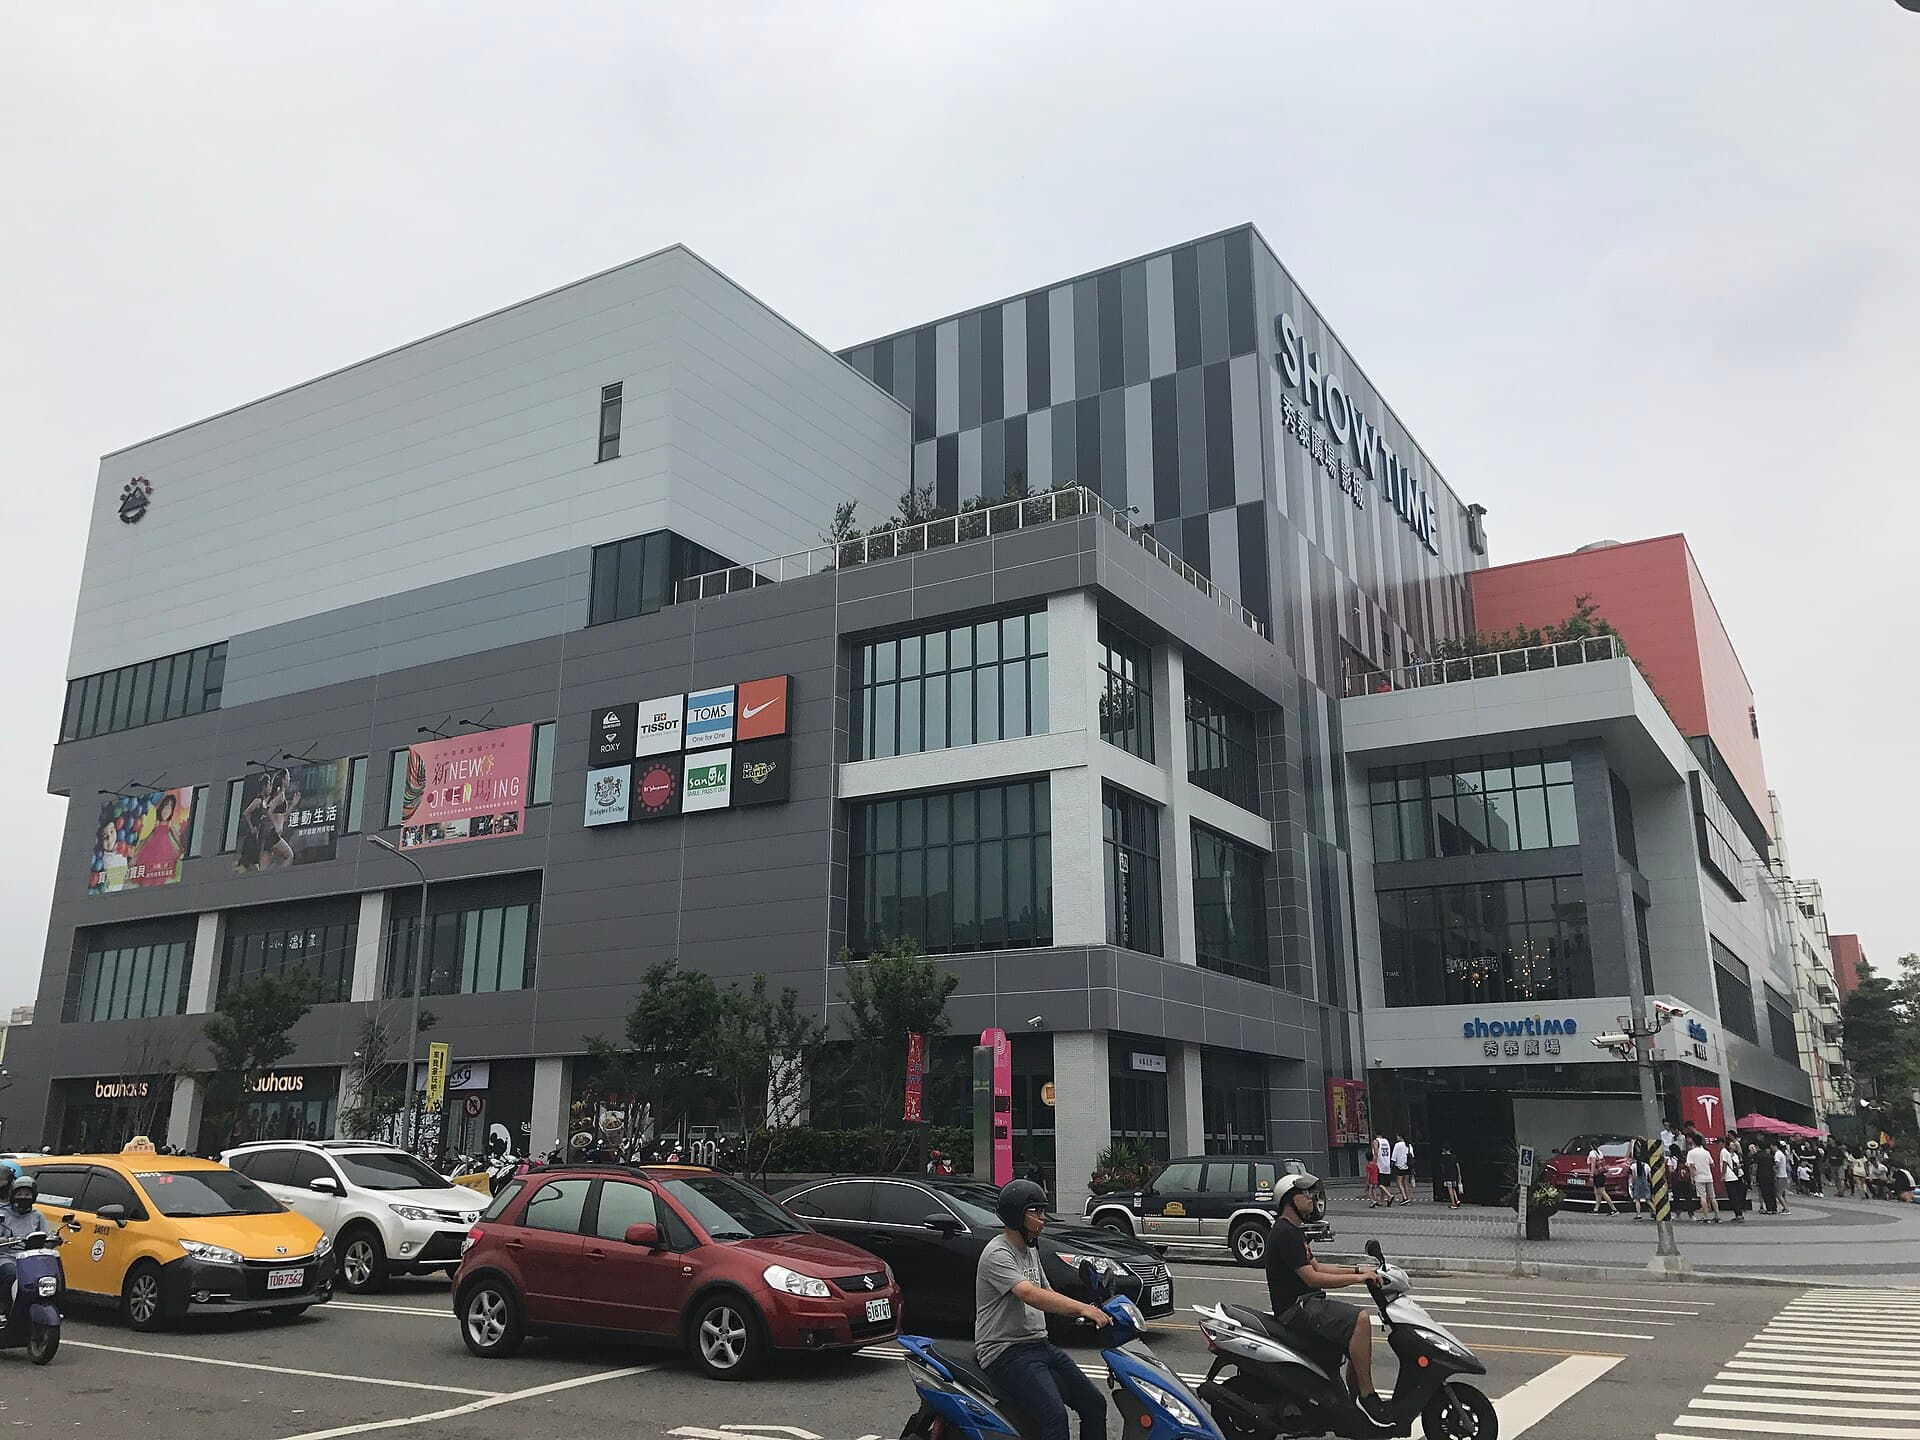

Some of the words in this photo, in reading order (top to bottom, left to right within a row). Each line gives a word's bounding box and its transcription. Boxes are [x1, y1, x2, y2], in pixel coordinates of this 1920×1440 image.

[1275, 312, 1439, 556] SHOWTIME
[694, 705, 727, 721] TOMS
[641, 720, 679, 734] TISSOT
[714, 732, 726, 740] One
[600, 742, 621, 753] ROXY
[449, 758, 482, 780] NEW
[742, 761, 777, 779] Martens
[288, 805, 337, 828] 運動生活
[1463, 1014, 1577, 1038] showtime
[1484, 1039, 1561, 1056] 秀泰廣場
[95, 1079, 149, 1098] bauhaus
